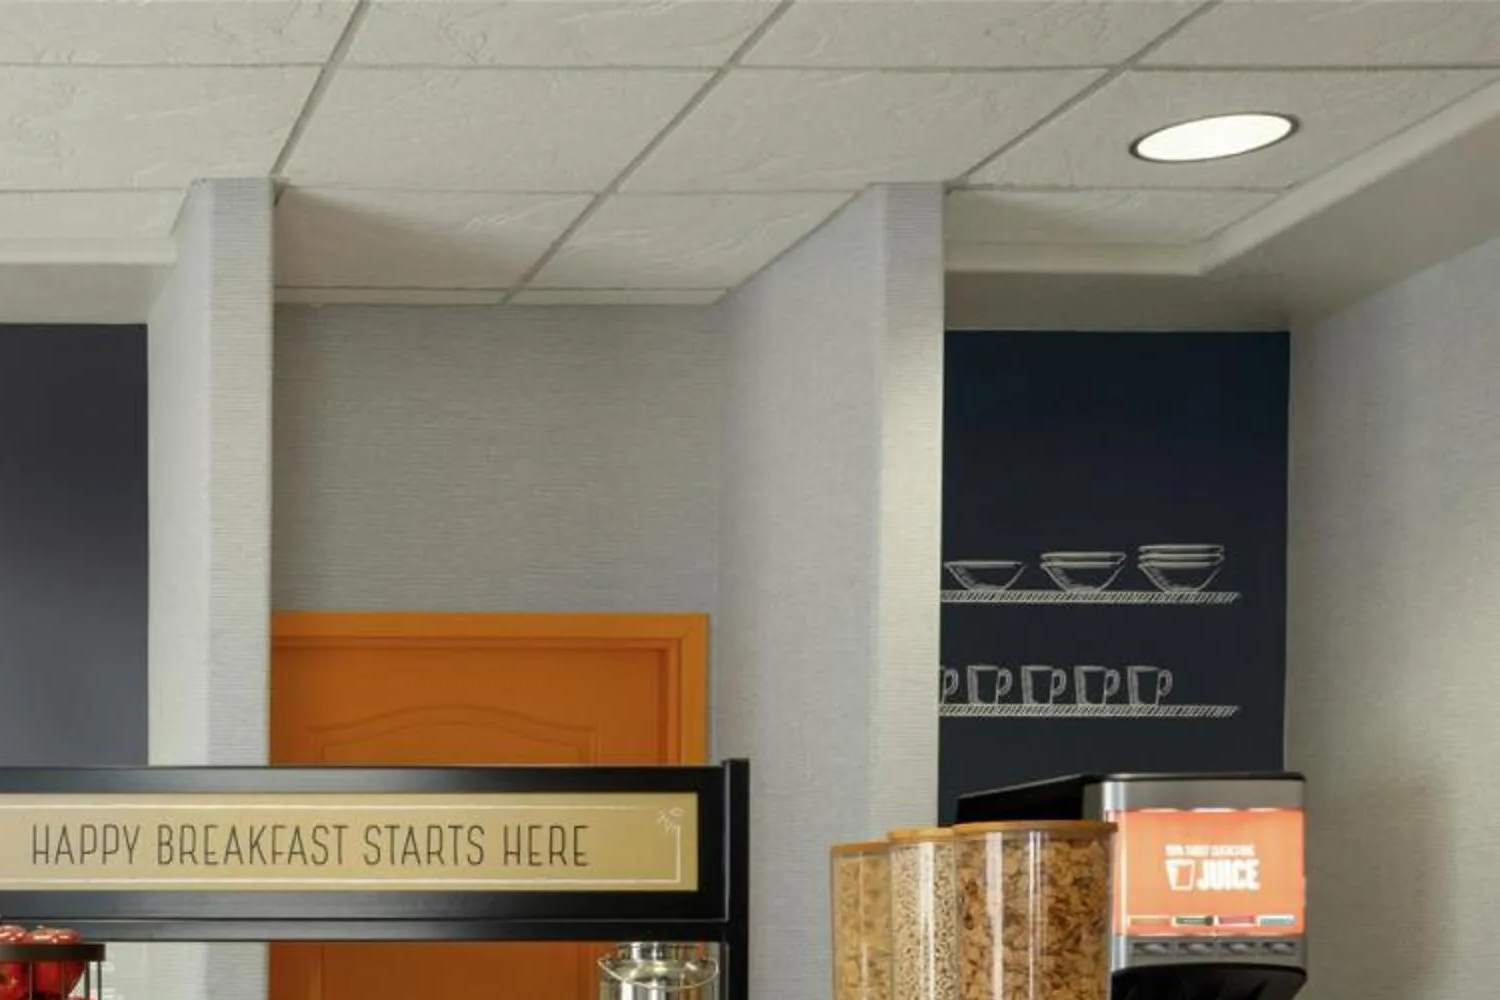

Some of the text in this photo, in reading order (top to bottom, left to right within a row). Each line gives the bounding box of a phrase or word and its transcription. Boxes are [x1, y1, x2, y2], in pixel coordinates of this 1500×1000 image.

[31, 823, 590, 867] HAPPY BREAKFAST STARTS HERE
[1197, 858, 1261, 891] JUICE
